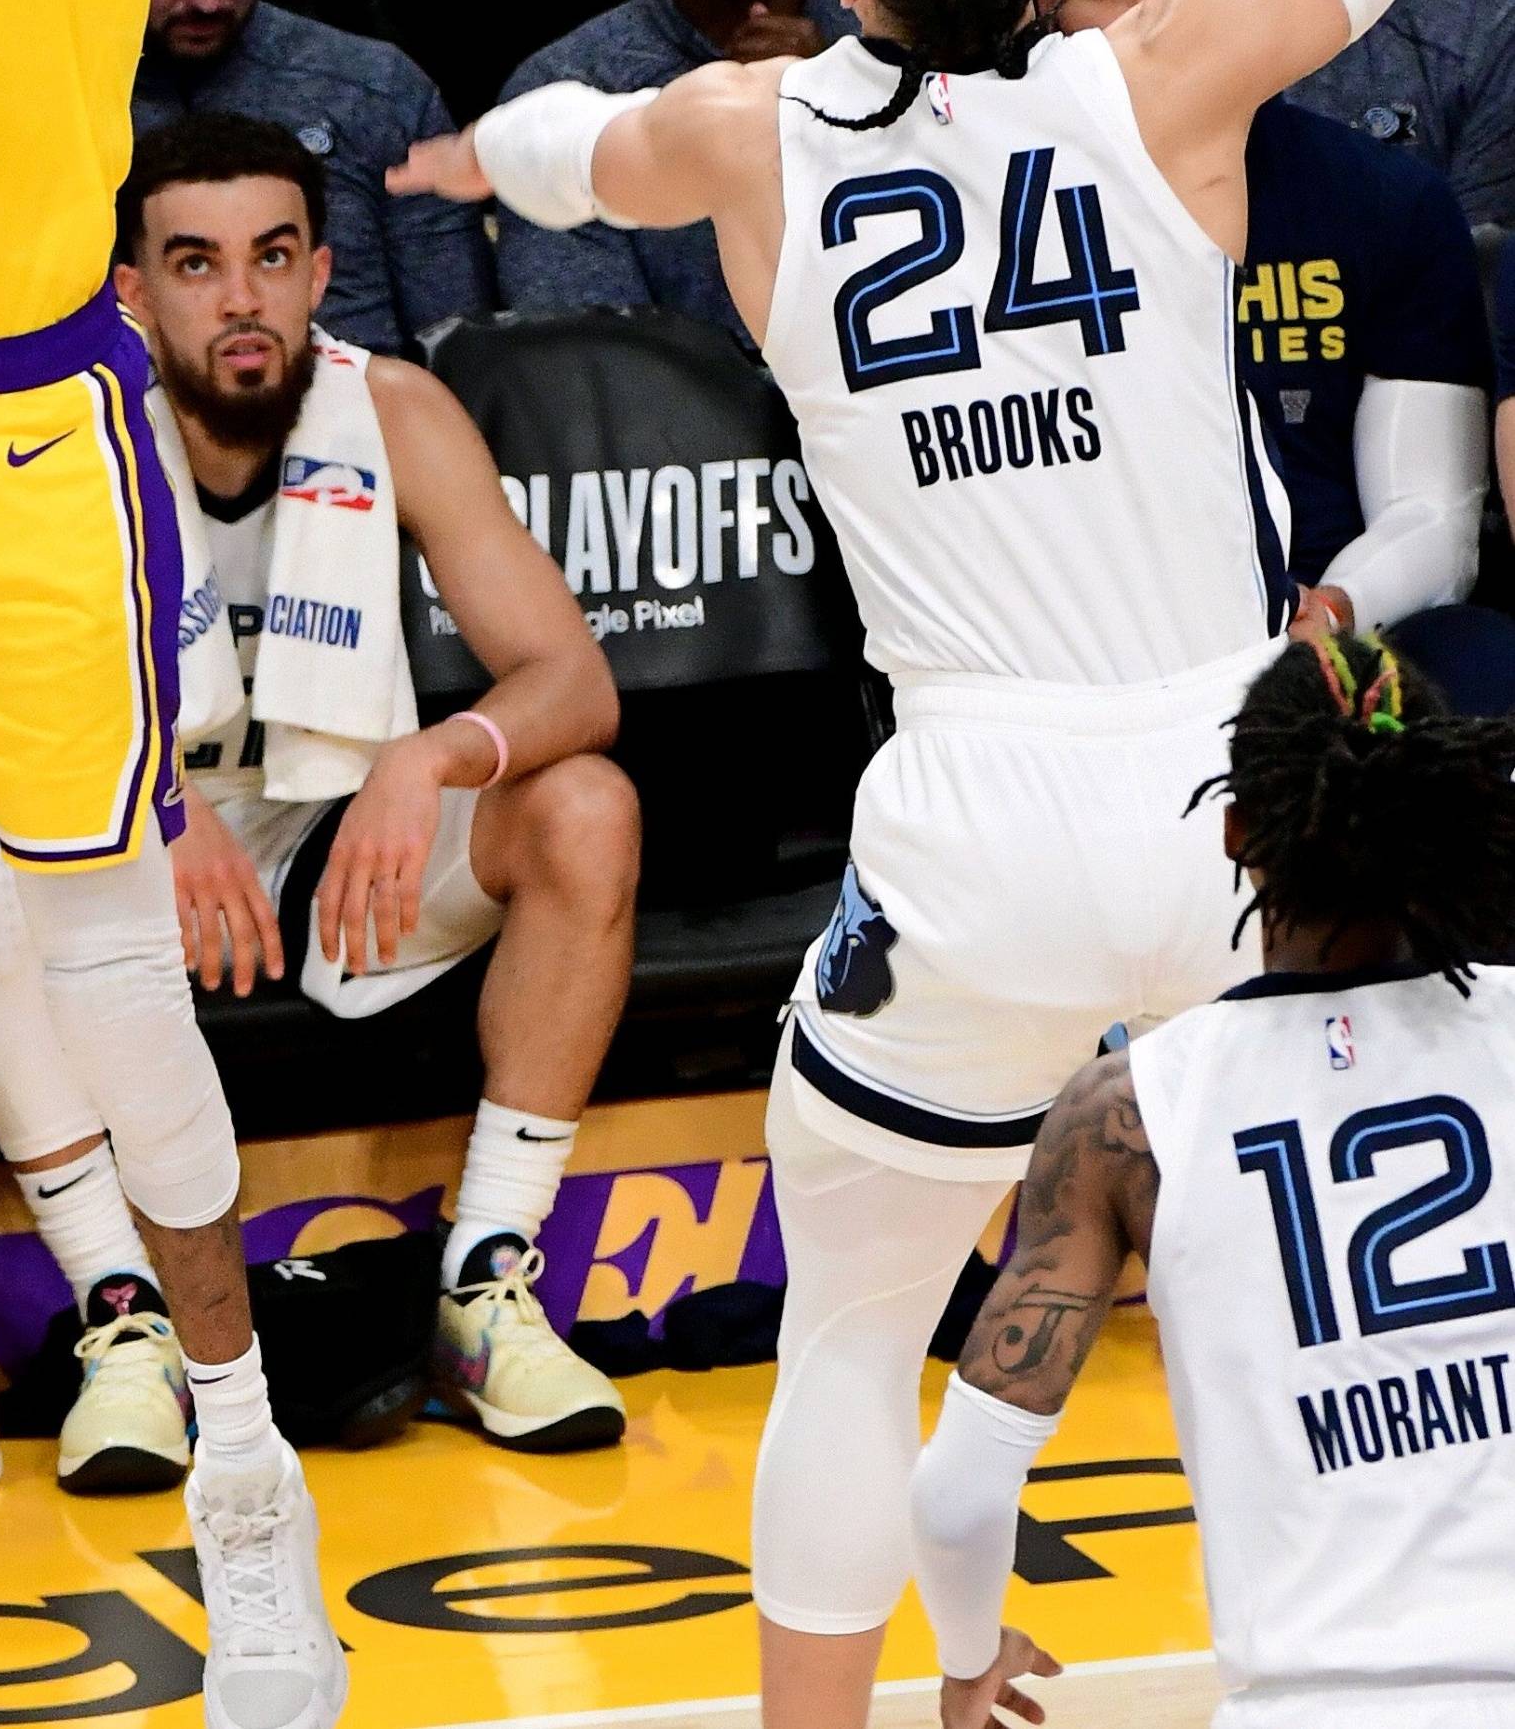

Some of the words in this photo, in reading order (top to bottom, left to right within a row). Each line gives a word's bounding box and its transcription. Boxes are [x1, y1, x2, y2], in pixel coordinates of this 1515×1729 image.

[821, 147, 1140, 393] 24
[901, 387, 1101, 488] BROOKS
[269, 595, 362, 650] CIATION
[633, 595, 705, 631] Pixel
[1233, 1094, 1515, 1348] 12
[1297, 1354, 1513, 1474] MORANT
